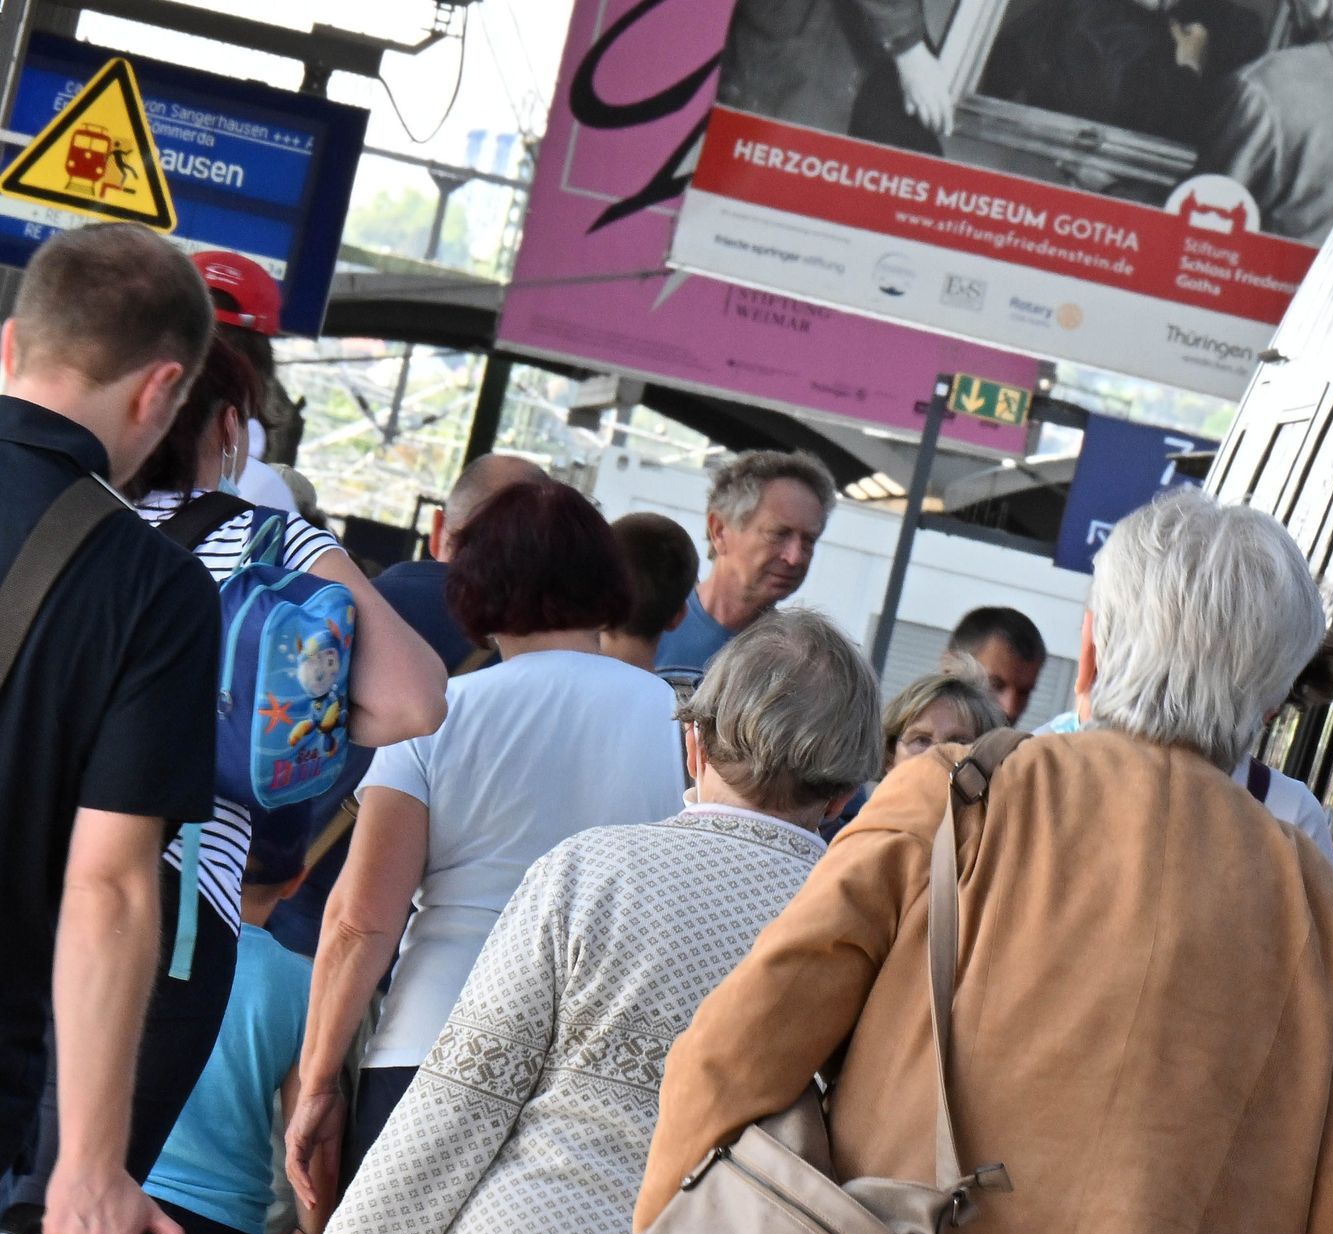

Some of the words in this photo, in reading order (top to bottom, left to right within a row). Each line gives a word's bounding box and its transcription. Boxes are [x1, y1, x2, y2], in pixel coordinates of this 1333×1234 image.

[171, 104, 268, 138] Sangerhausen
[158, 147, 244, 188] ausen
[733, 139, 930, 201] HERZOGLICHES
[936, 187, 1047, 230] MUSEUM
[1053, 214, 1140, 252] GOTHA
[895, 210, 1135, 276] www.stiftungfriedenstein.de
[1184, 236, 1240, 266] Stiftung
[1175, 273, 1222, 296] Gotha
[1179, 255, 1232, 281] Schloss
[1234, 268, 1300, 295] Friedens
[735, 304, 811, 333] WEIMAR
[1166, 324, 1253, 363] Thüringen
[1160, 435, 1195, 486] 7
